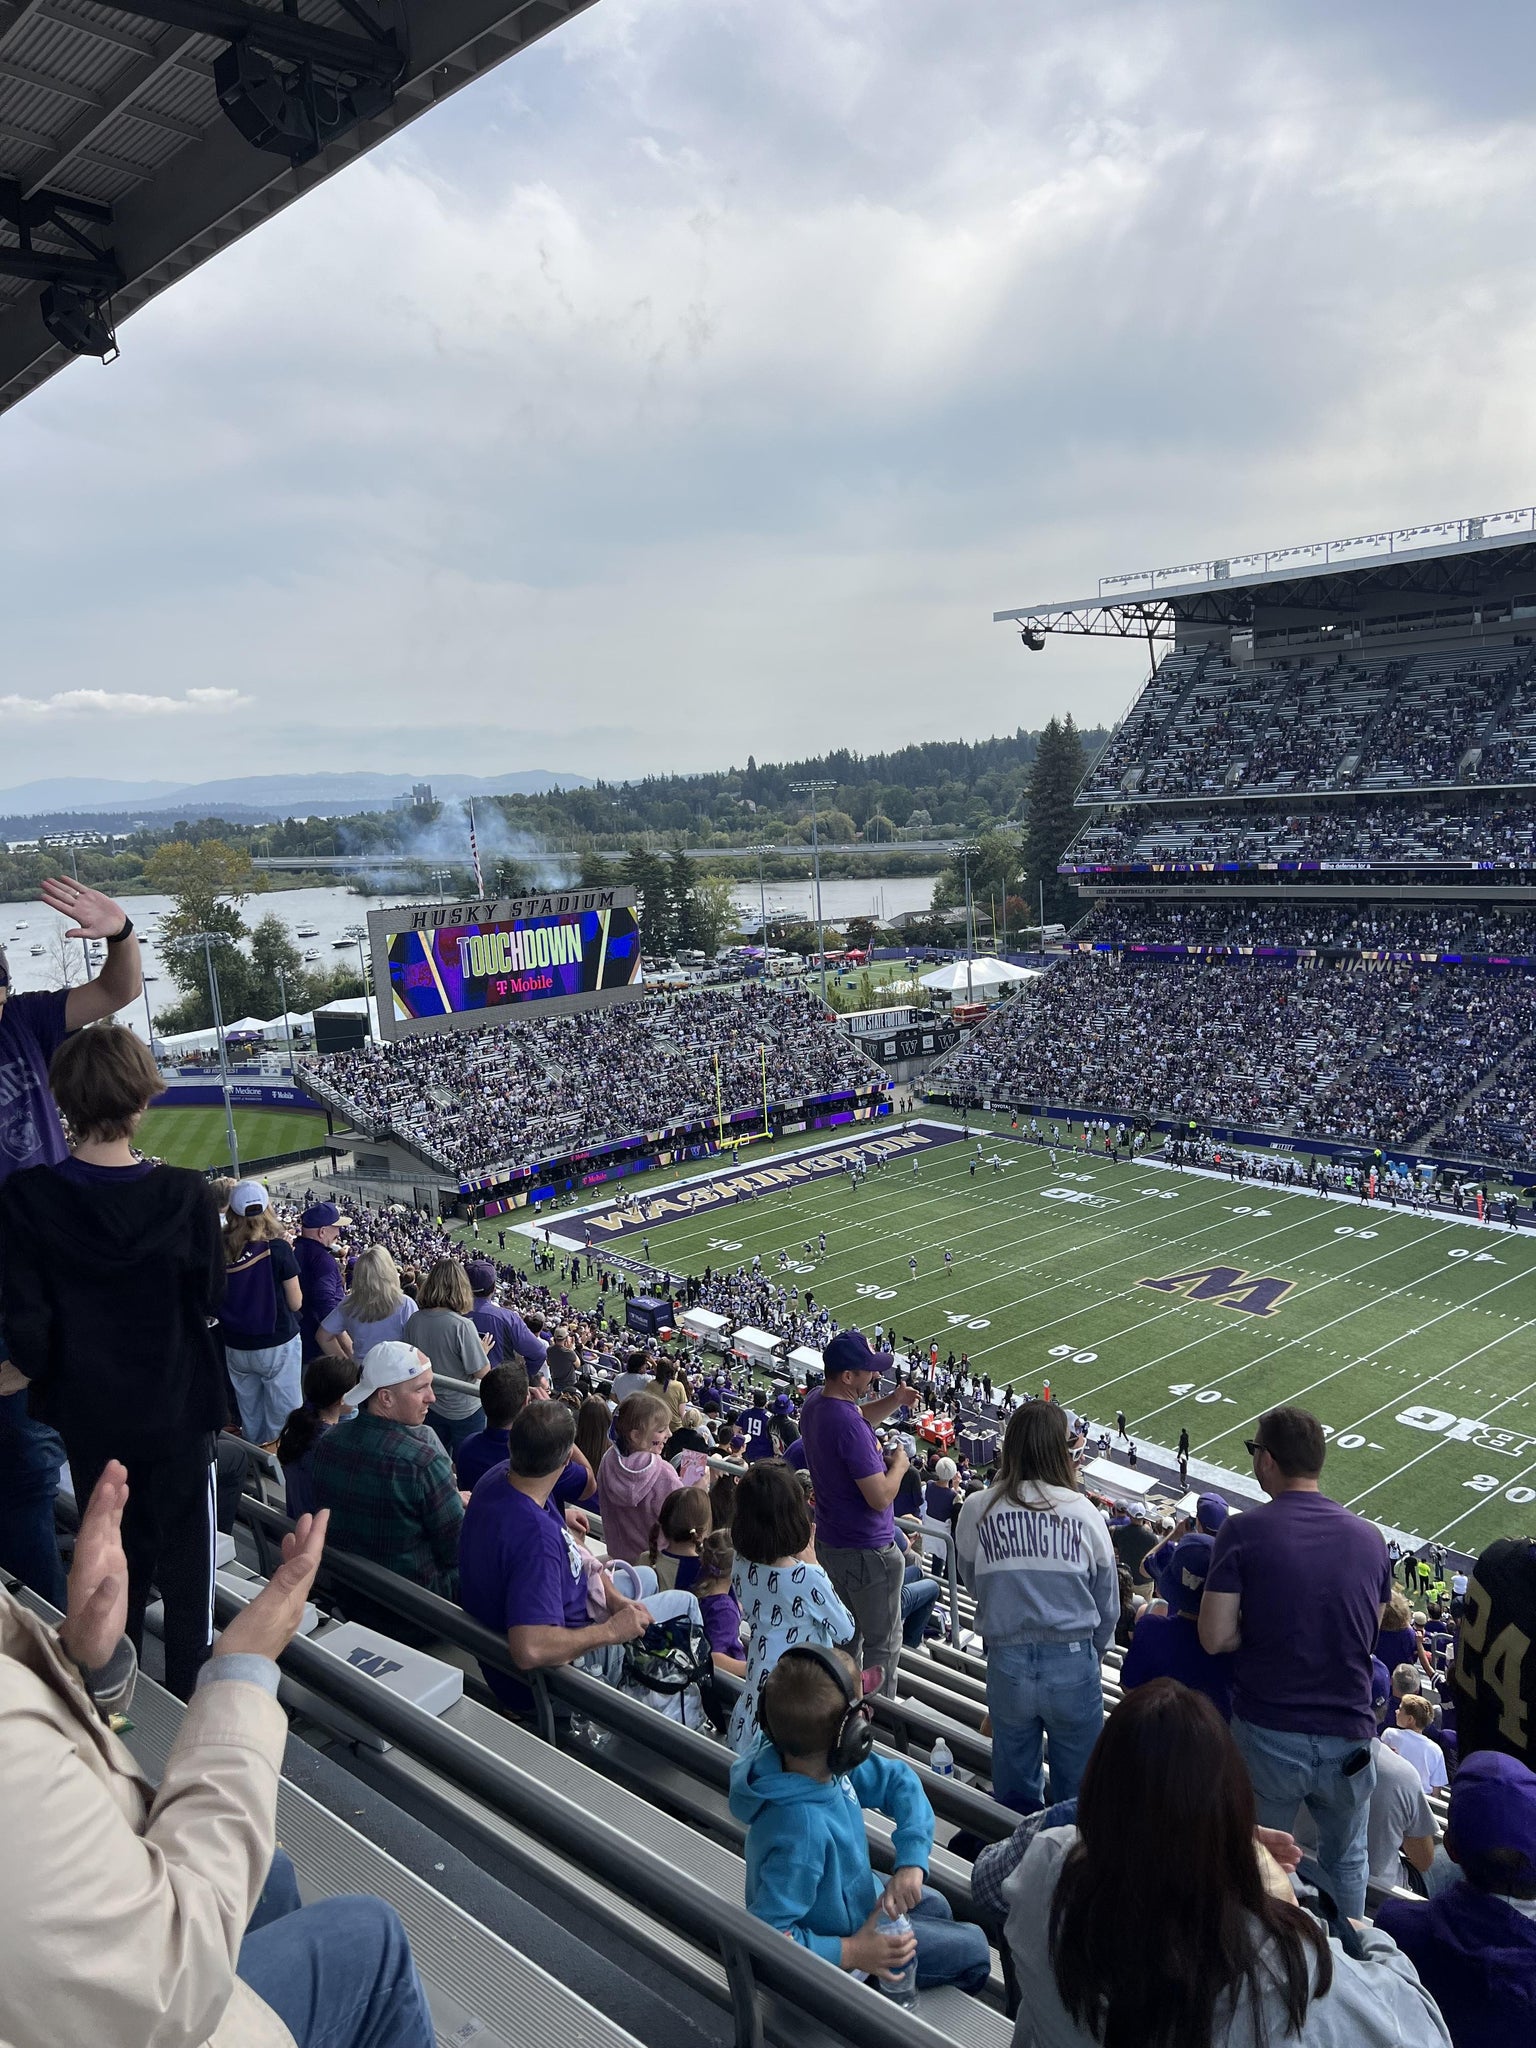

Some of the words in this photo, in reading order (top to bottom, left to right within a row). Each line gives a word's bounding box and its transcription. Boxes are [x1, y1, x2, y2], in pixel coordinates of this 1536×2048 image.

[411, 903, 498, 929] HUSKY
[511, 891, 616, 918] STADIUM
[456, 923, 584, 979] TOUCHDOWN
[510, 976, 554, 994] Mobile
[851, 1016, 867, 1032] UTAH
[868, 1013, 884, 1030] STATE
[884, 1010, 910, 1028] FOOTBALL
[901, 1039, 918, 1056] W
[278, 1091, 294, 1099] Mobile
[583, 1131, 933, 1231] WASHINGTON
[856, 1284, 898, 1300] 30
[1133, 1264, 1299, 1319] W
[947, 1314, 991, 1330] 40
[1048, 1344, 1098, 1364] 50
[1167, 1382, 1223, 1404] 40
[747, 1417, 762, 1436] 19
[1462, 1474, 1536, 1503] 20
[976, 1511, 1083, 1564] WASHINGTON
[346, 1646, 404, 1678] W
[1455, 1574, 1531, 1750] 24
